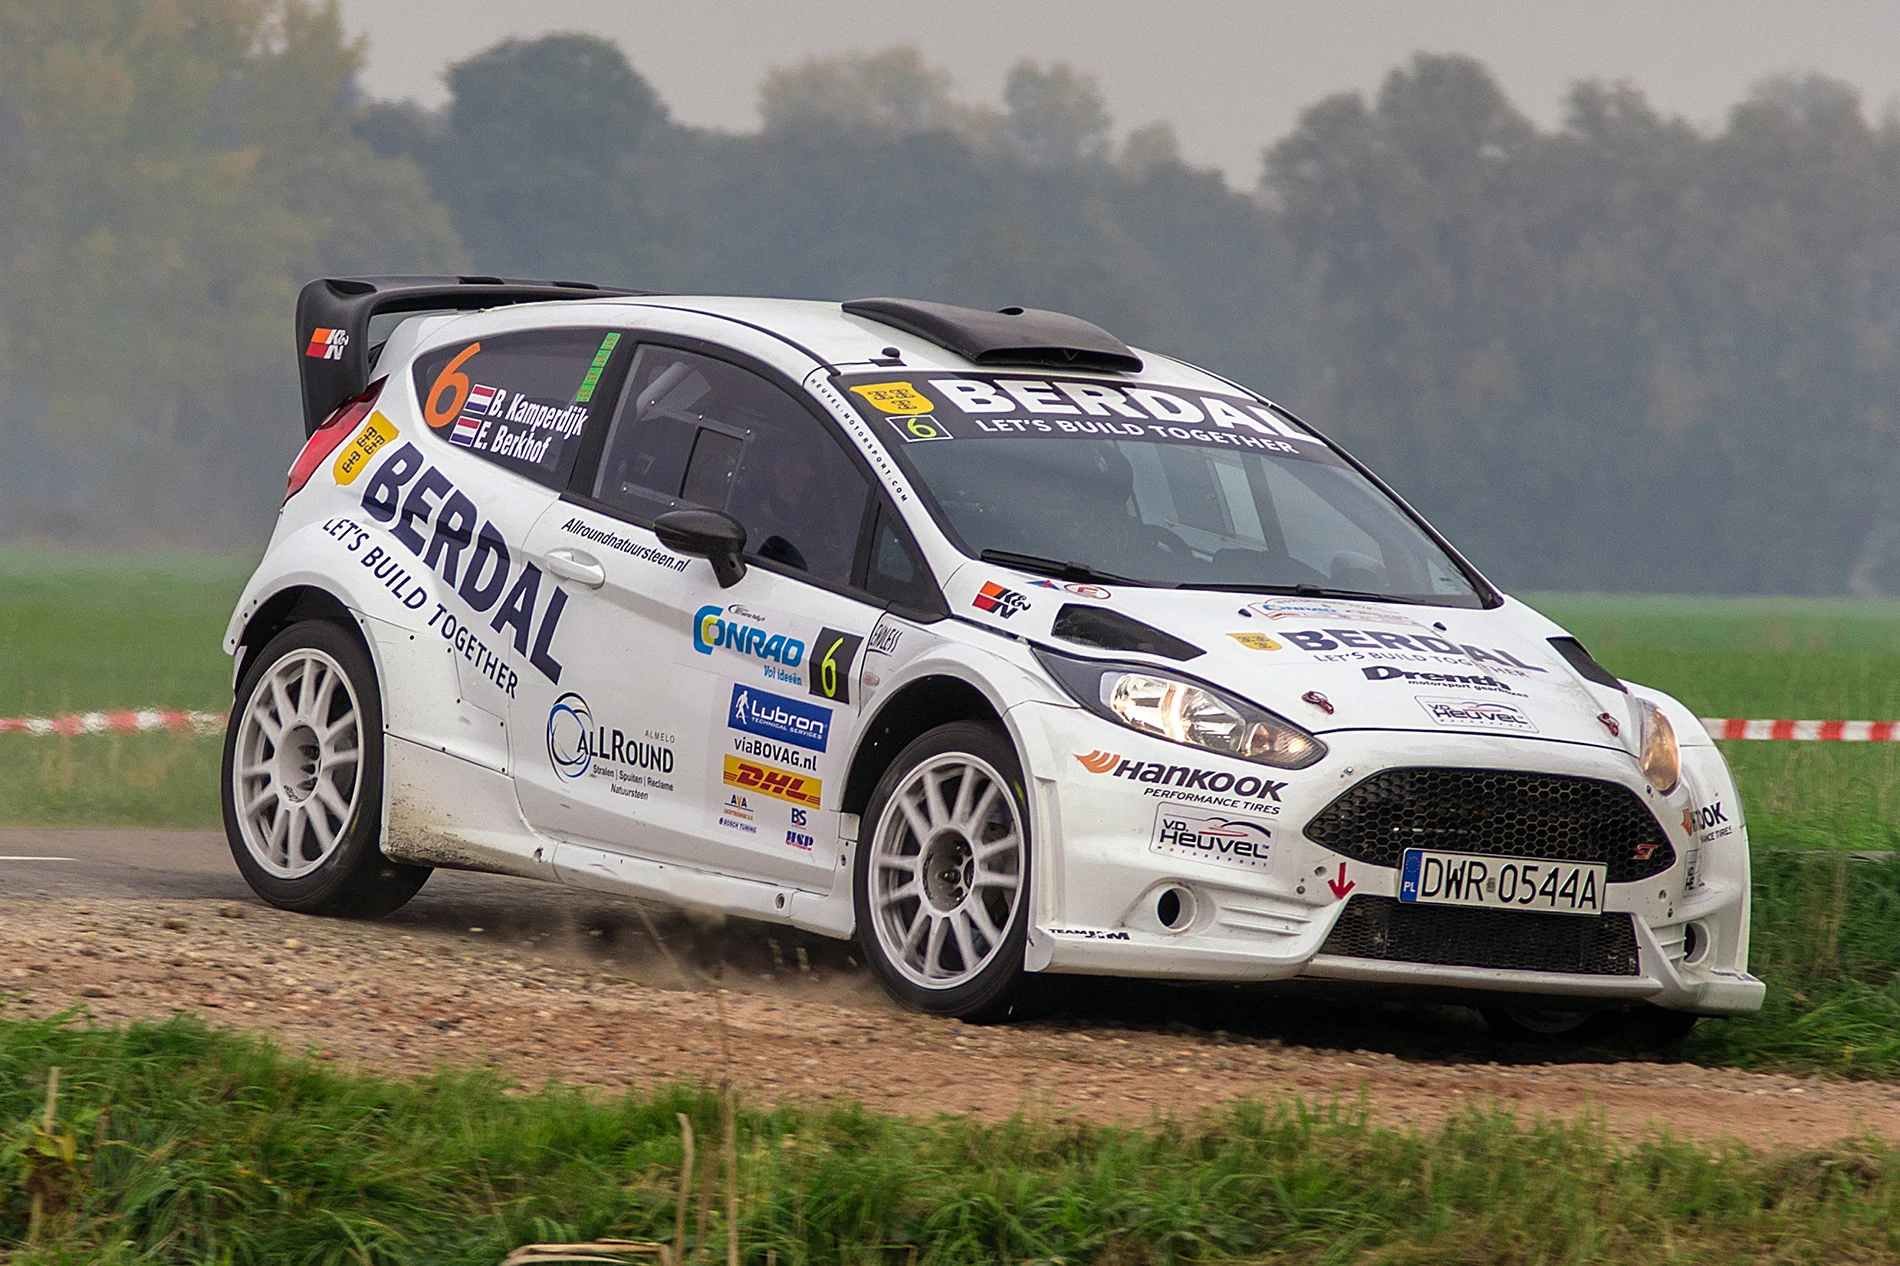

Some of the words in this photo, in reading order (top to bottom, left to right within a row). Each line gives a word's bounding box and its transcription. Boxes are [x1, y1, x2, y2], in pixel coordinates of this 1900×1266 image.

[424, 341, 481, 428] 6
[488, 389, 507, 418] B.
[505, 393, 589, 440] Kamperdijk
[907, 418, 937, 438] 6
[928, 379, 1328, 447] BERDAL
[473, 421, 492, 450] E.
[490, 425, 552, 464] Berkhof
[975, 419, 1052, 432] LET'S
[1054, 420, 1146, 436] BUILD
[1148, 425, 1300, 454] TOGETHER
[561, 517, 691, 573] Allroundnatuursteen.nl
[360, 441, 569, 686] BERDAL
[322, 518, 370, 552] LET'S
[360, 546, 428, 610] BUILD
[427, 603, 518, 699] TOGETHER
[693, 605, 805, 668] CONRAD
[1277, 628, 1548, 674] BERDAL
[764, 664, 776, 679] Vol
[821, 637, 844, 698] 6
[1313, 651, 1365, 663] LET'S
[1368, 652, 1428, 662] BUILD
[1361, 665, 1512, 691] Drenth
[751, 699, 824, 734] Lubron
[751, 716, 788, 731] TECHNICAL
[789, 727, 822, 740] SERVICES
[644, 729, 676, 744] ALMELO
[734, 736, 817, 772] viaBOVAG.nl
[592, 764, 615, 778] Stralen
[619, 770, 643, 785] Spuiten
[647, 776, 674, 792] Reclame
[610, 783, 649, 800] Natuursteen
[736, 763, 808, 801] DHL
[1144, 788, 1240, 809] PERFORMANCE
[1243, 801, 1281, 815] TIRES
[1403, 881, 1416, 893] PL
[1421, 857, 1488, 902] DWR
[1498, 863, 1598, 910] 0544A
